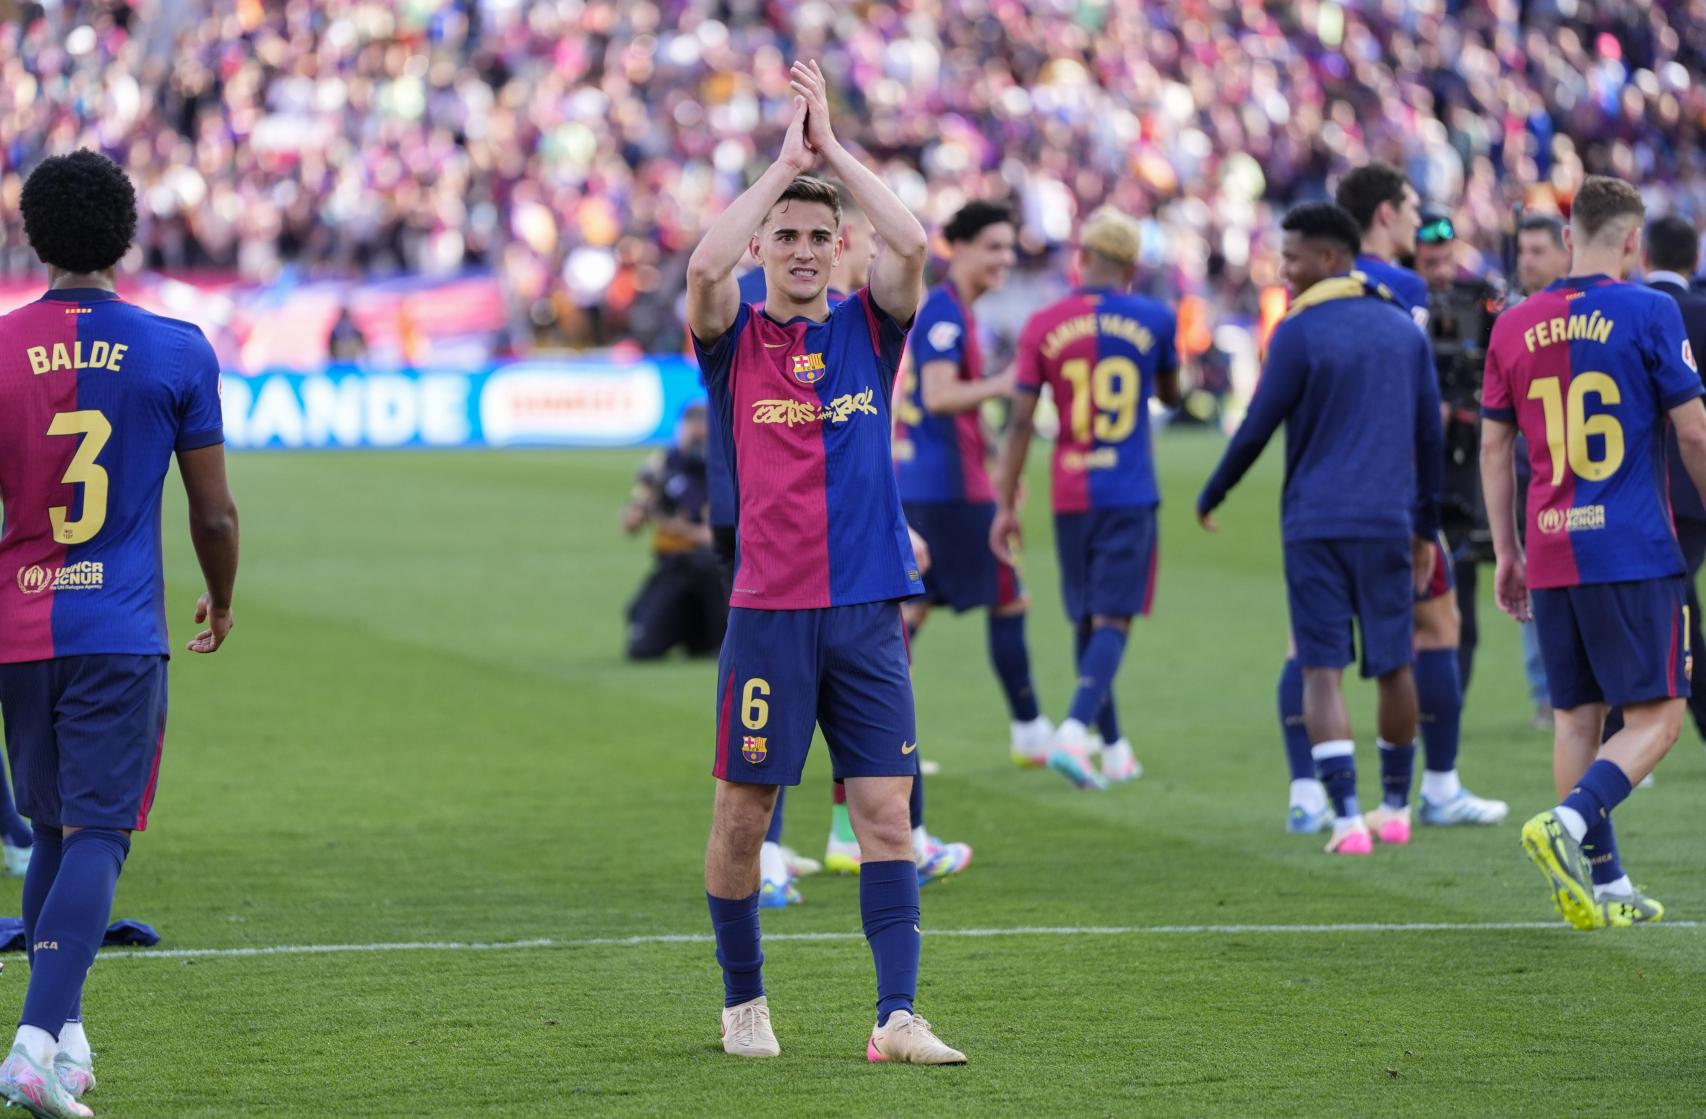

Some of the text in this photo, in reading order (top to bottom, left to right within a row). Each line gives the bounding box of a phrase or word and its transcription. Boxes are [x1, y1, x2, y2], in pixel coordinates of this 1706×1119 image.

[1523, 310, 1614, 353] FERMÍN
[27, 340, 128, 375] BALDE
[1060, 356, 1139, 443] 19
[1527, 371, 1625, 486] 16
[46, 410, 112, 545] 3
[51, 573, 103, 585] ACNUR
[55, 561, 103, 577] UNHCR
[741, 677, 770, 730] 6
